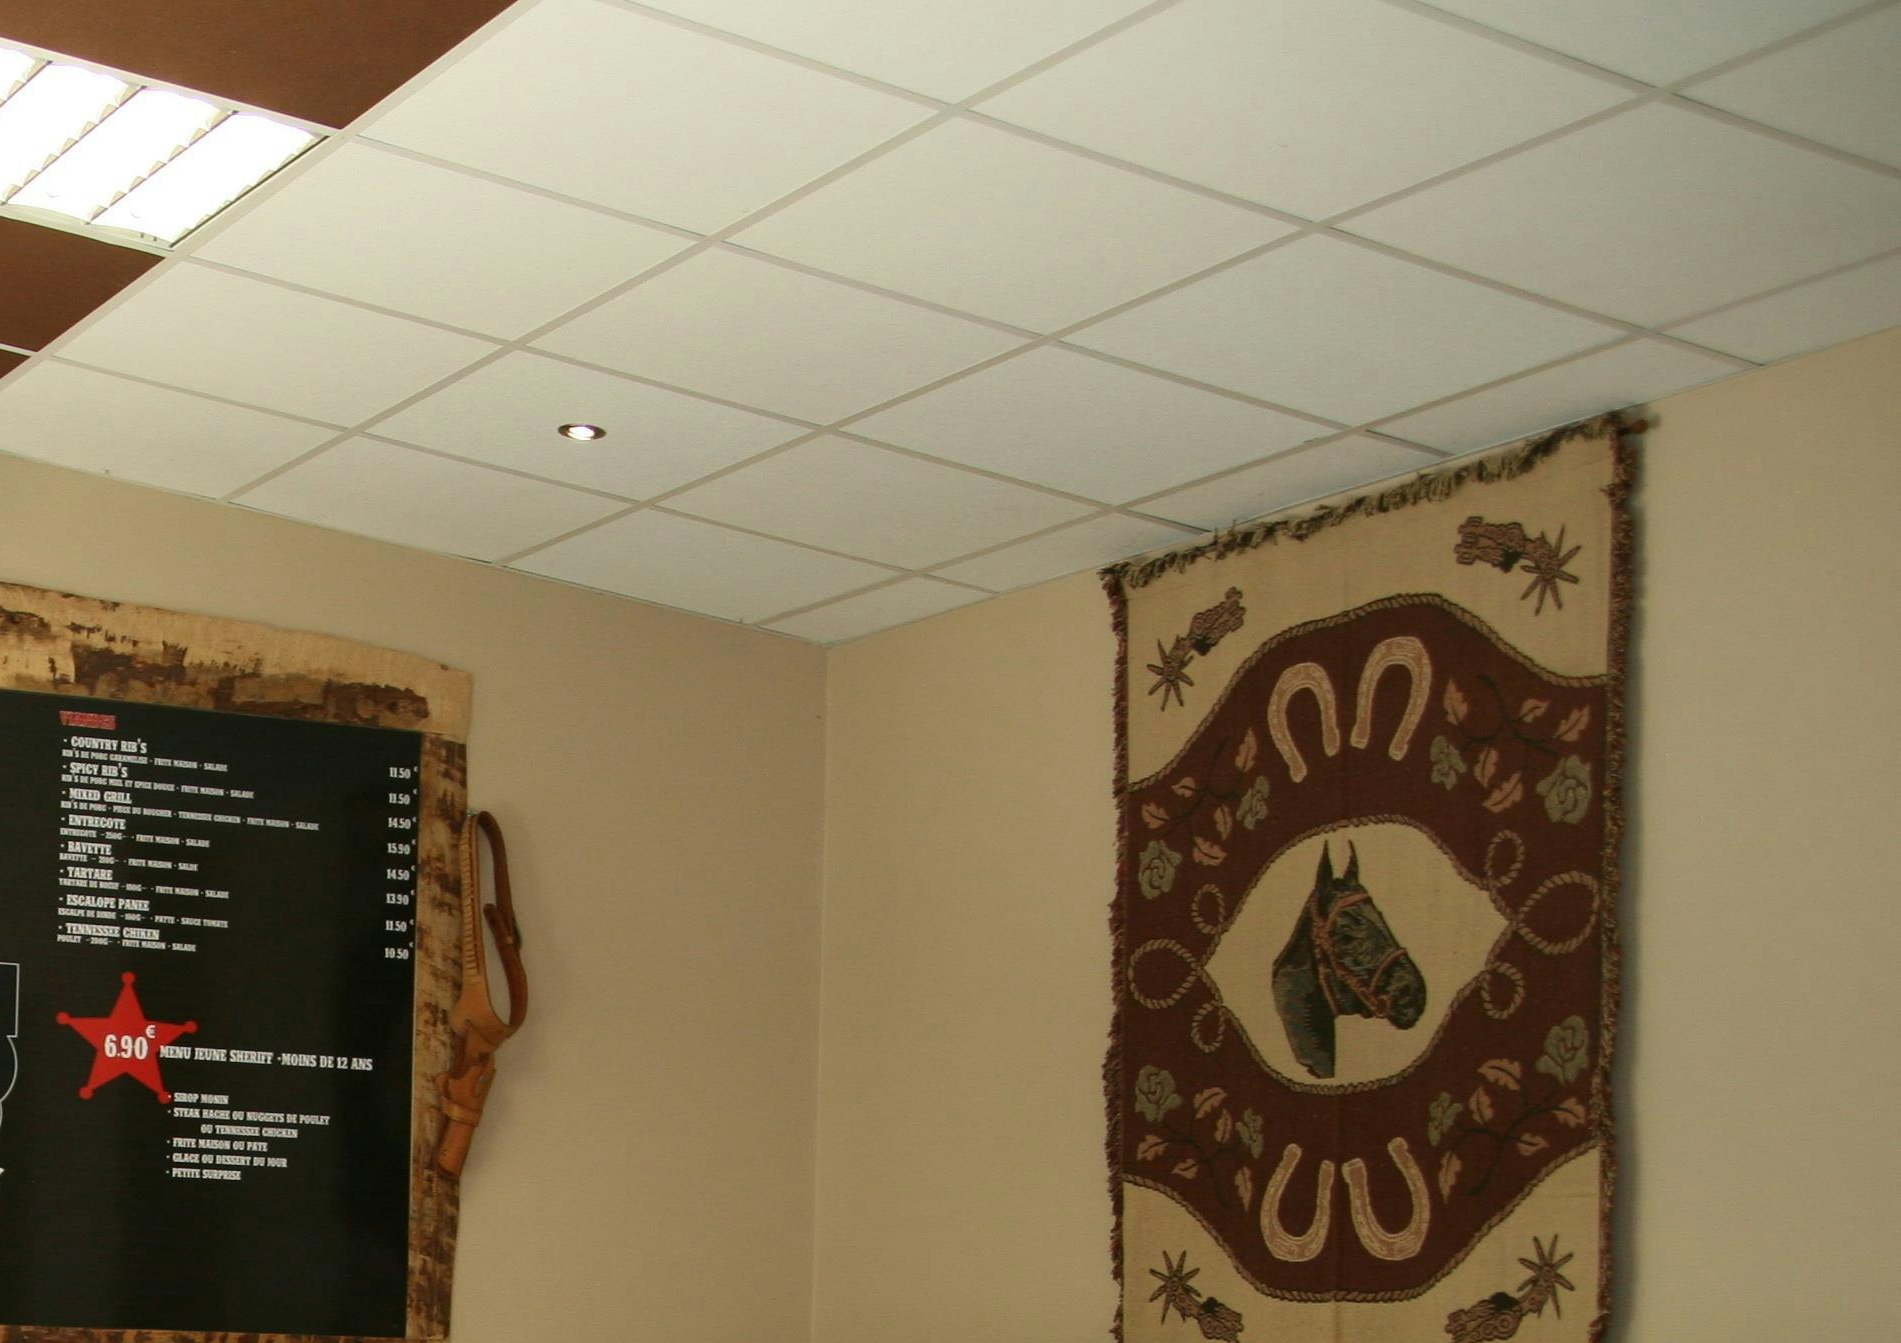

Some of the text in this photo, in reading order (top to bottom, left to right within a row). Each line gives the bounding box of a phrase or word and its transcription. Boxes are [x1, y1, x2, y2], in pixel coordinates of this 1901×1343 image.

[70, 735, 118, 751] COUNTRY
[69, 761, 99, 776] SPICY
[69, 787, 132, 804] MIXED GRILL
[68, 814, 126, 830] ENTRECOTE
[67, 840, 112, 856] BAVETTE
[66, 866, 113, 881] TARTARE
[66, 894, 116, 909] ESCALOPE
[159, 1045, 192, 1060] MENU
[193, 1047, 227, 1062] JEUNE
[229, 1049, 274, 1064] SHERIFF
[319, 1055, 334, 1068] DE
[336, 1056, 348, 1069] 12
[350, 1057, 373, 1071] ANS
[173, 1092, 199, 1103] SIROP
[173, 1107, 201, 1118] STEAK
[231, 1110, 245, 1121] OU
[246, 1111, 285, 1123] NUGGETS
[286, 1113, 298, 1124] DE
[299, 1114, 330, 1125] POULET
[200, 1123, 213, 1134] OU
[261, 1127, 298, 1139] CHICKEN
[172, 1137, 197, 1148] FRITE
[198, 1138, 231, 1150] MAISON
[232, 1140, 245, 1151] OU
[172, 1152, 287, 1168] GLACE OU DESSERT DU JOUR
[172, 1167, 241, 1181] PETITE SURPRISE
